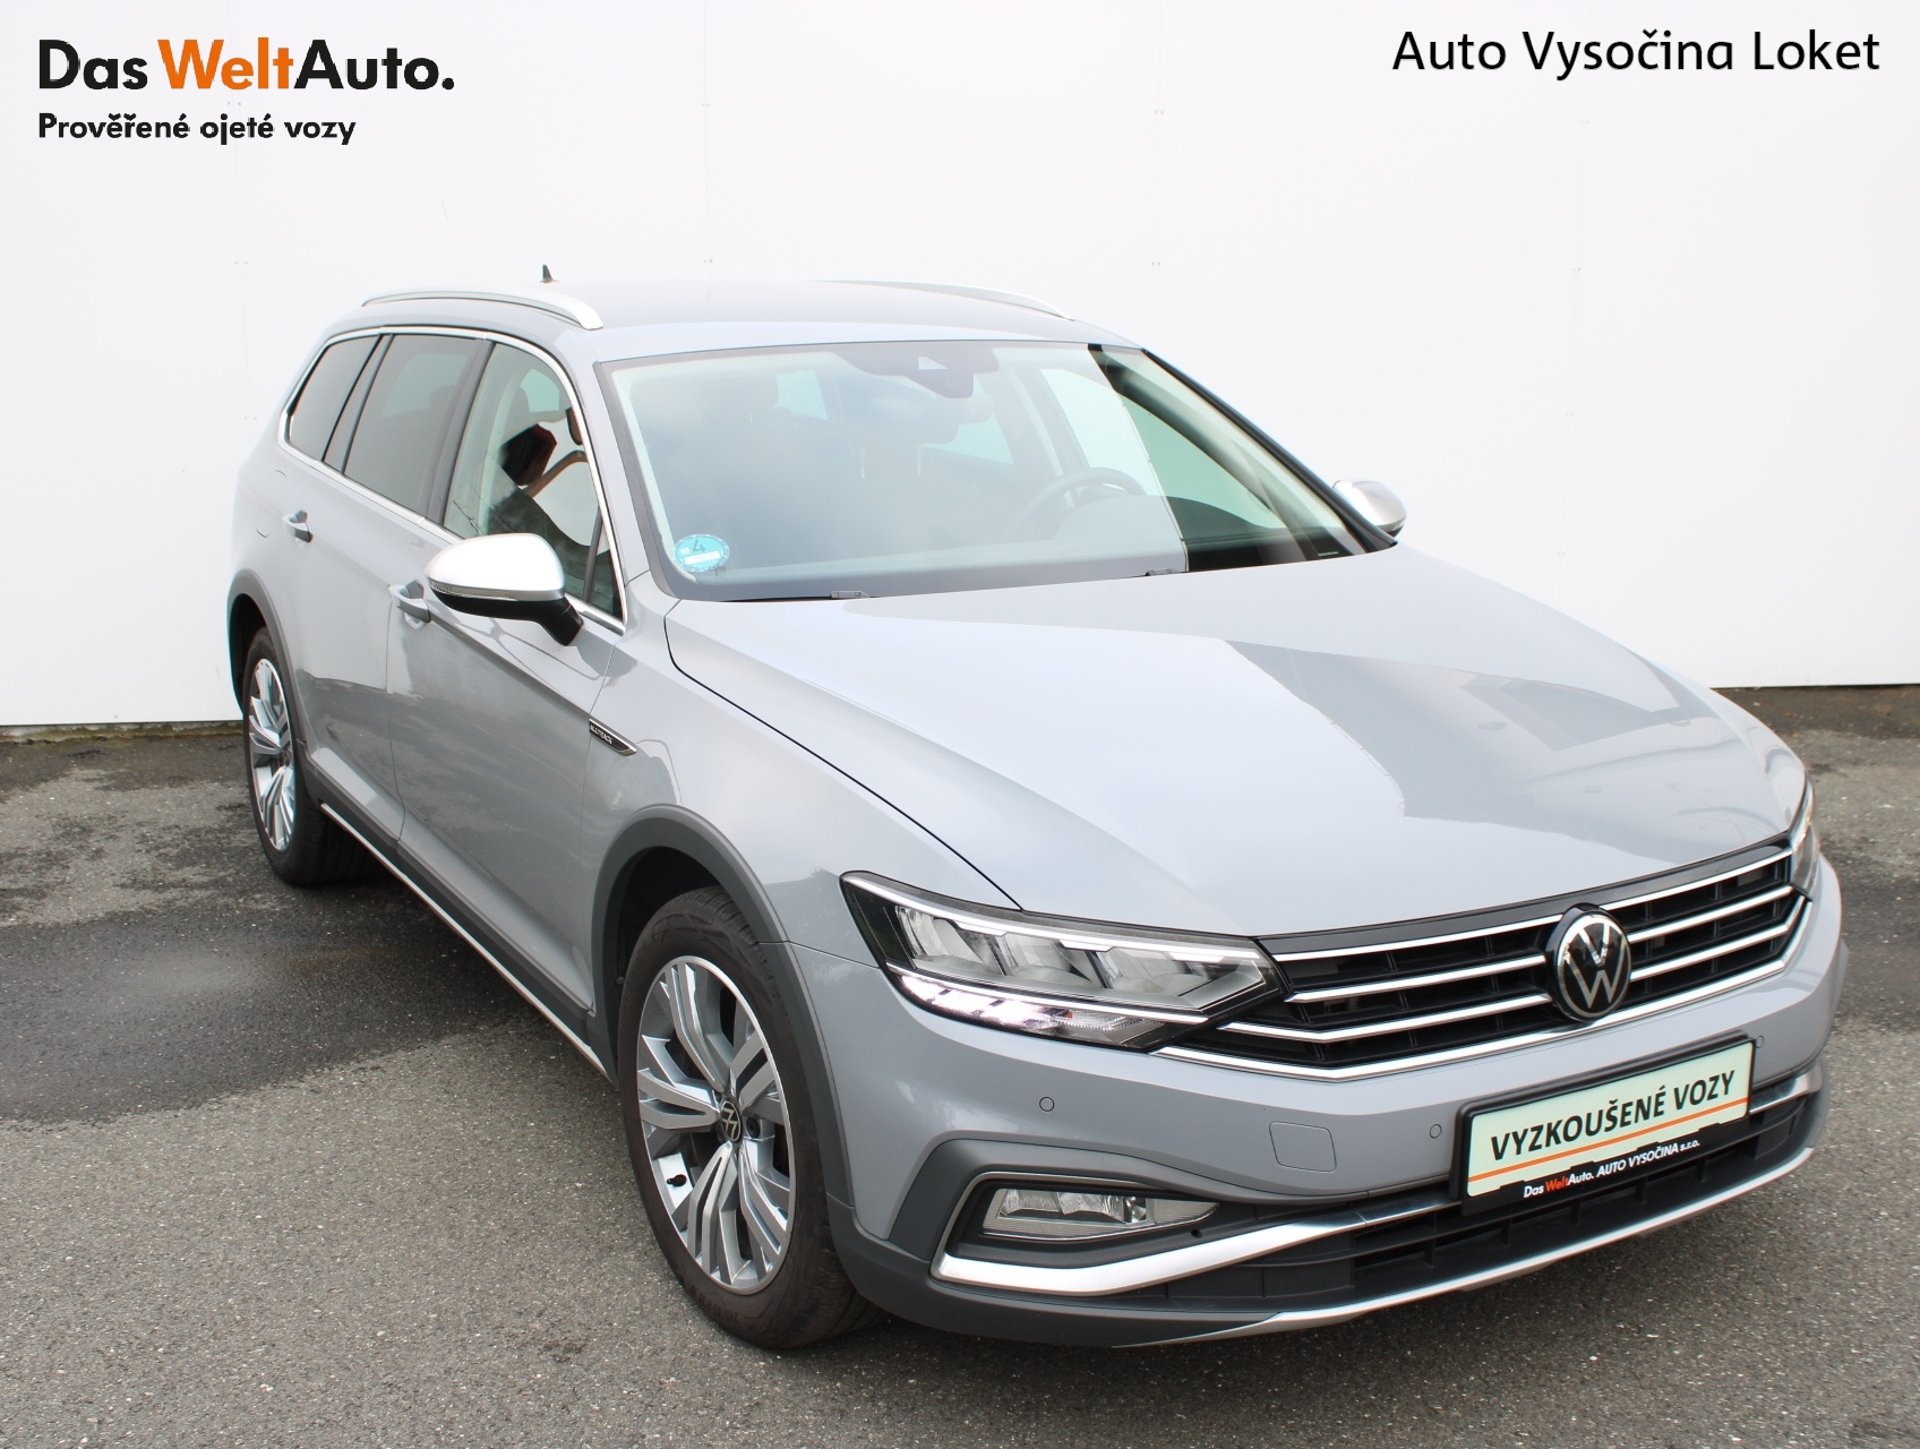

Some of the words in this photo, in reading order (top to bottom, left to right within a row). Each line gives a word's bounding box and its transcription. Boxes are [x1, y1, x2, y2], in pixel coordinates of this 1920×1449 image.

[1490, 1084, 1666, 1160] VYZKOUŠENÉ
[1673, 1070, 1735, 1110] VOZY
[1523, 1185, 1544, 1198] Das
[1545, 1172, 1595, 1192] WeltAuto.
[1596, 1159, 1627, 1178] AUTO
[1628, 1143, 1679, 1168] VYSOČINA
[1680, 1139, 1700, 1151] s.r.o.
